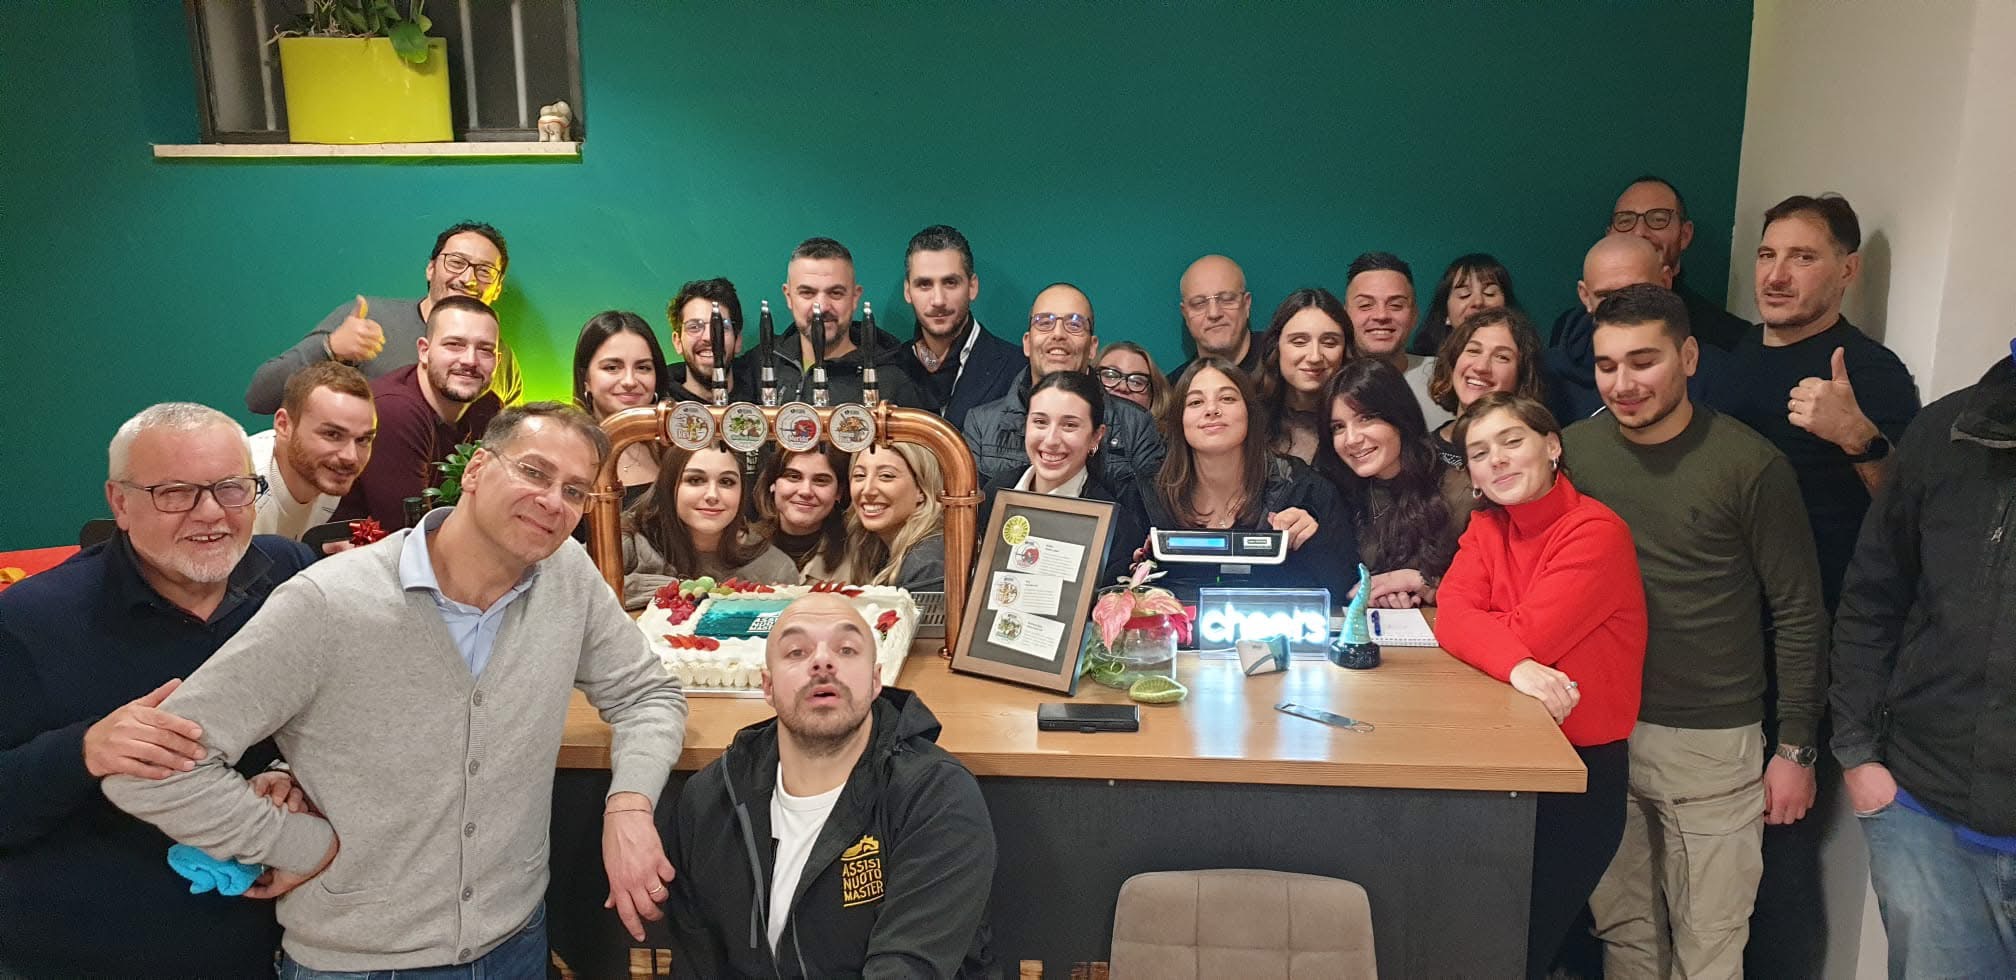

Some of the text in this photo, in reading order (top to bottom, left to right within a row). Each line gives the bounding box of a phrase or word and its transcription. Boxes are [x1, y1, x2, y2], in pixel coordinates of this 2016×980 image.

[1202, 602, 1327, 643] cheers
[842, 858, 881, 877] ASSISI
[843, 869, 882, 890] NUOTO
[843, 880, 884, 902] MASTER
